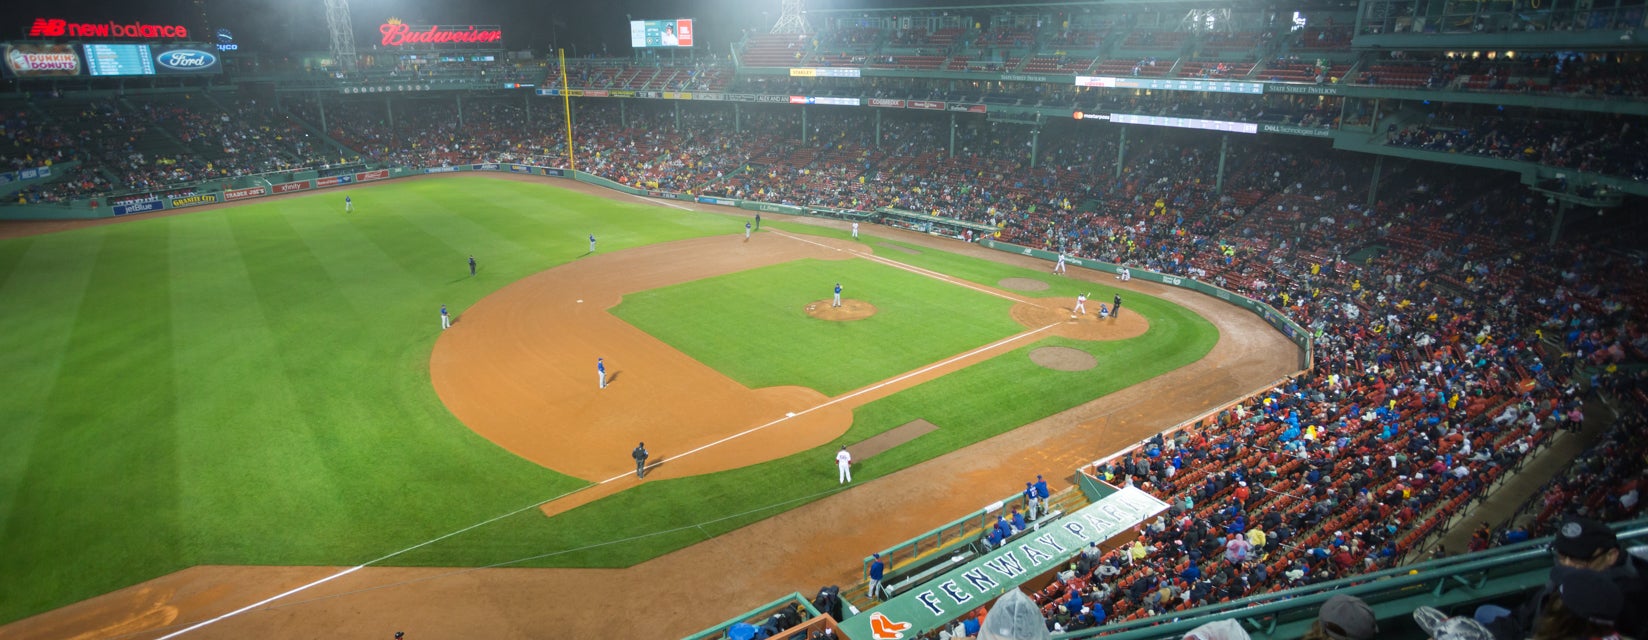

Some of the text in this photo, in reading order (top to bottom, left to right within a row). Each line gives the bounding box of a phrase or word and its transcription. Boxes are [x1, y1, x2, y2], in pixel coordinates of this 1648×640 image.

[67, 23, 109, 37] new
[109, 20, 187, 38] balance
[380, 23, 501, 46] Budweiser
[169, 51, 205, 66] Ford
[1308, 86, 1337, 94] PAVILION
[281, 183, 301, 192] xfinity
[225, 191, 248, 199] TRADER
[125, 203, 153, 214] jetBlue
[915, 532, 1067, 616] FENWAY
